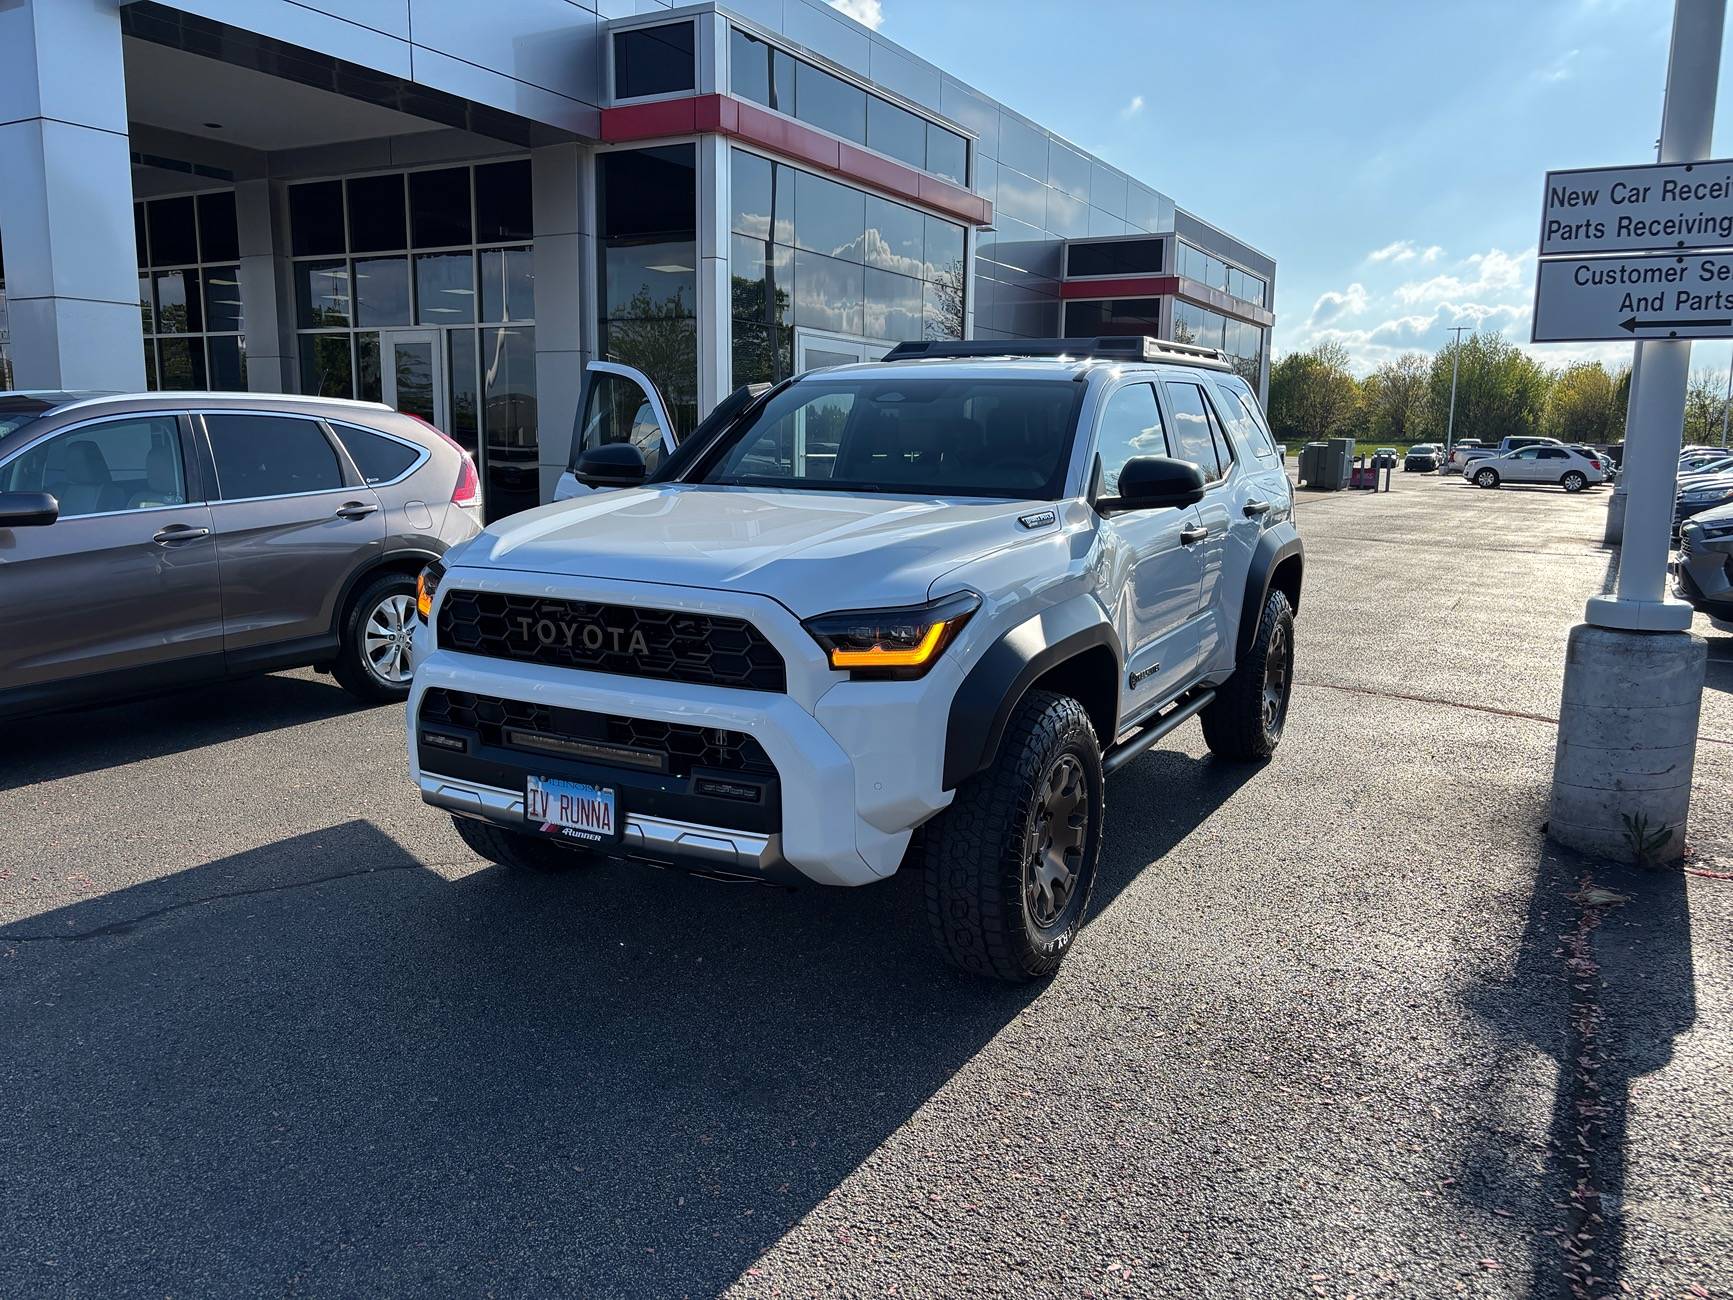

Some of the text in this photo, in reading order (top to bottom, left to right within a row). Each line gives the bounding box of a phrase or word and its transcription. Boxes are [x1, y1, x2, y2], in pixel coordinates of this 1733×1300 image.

[1550, 186, 1599, 209] New
[1610, 182, 1651, 205] Car
[1547, 212, 1733, 241] Parts Receiving
[1574, 260, 1733, 286] Customer Se
[1618, 290, 1733, 313] And Parts
[517, 617, 649, 655] TOYOTA
[530, 788, 611, 831] IV RUNNA
